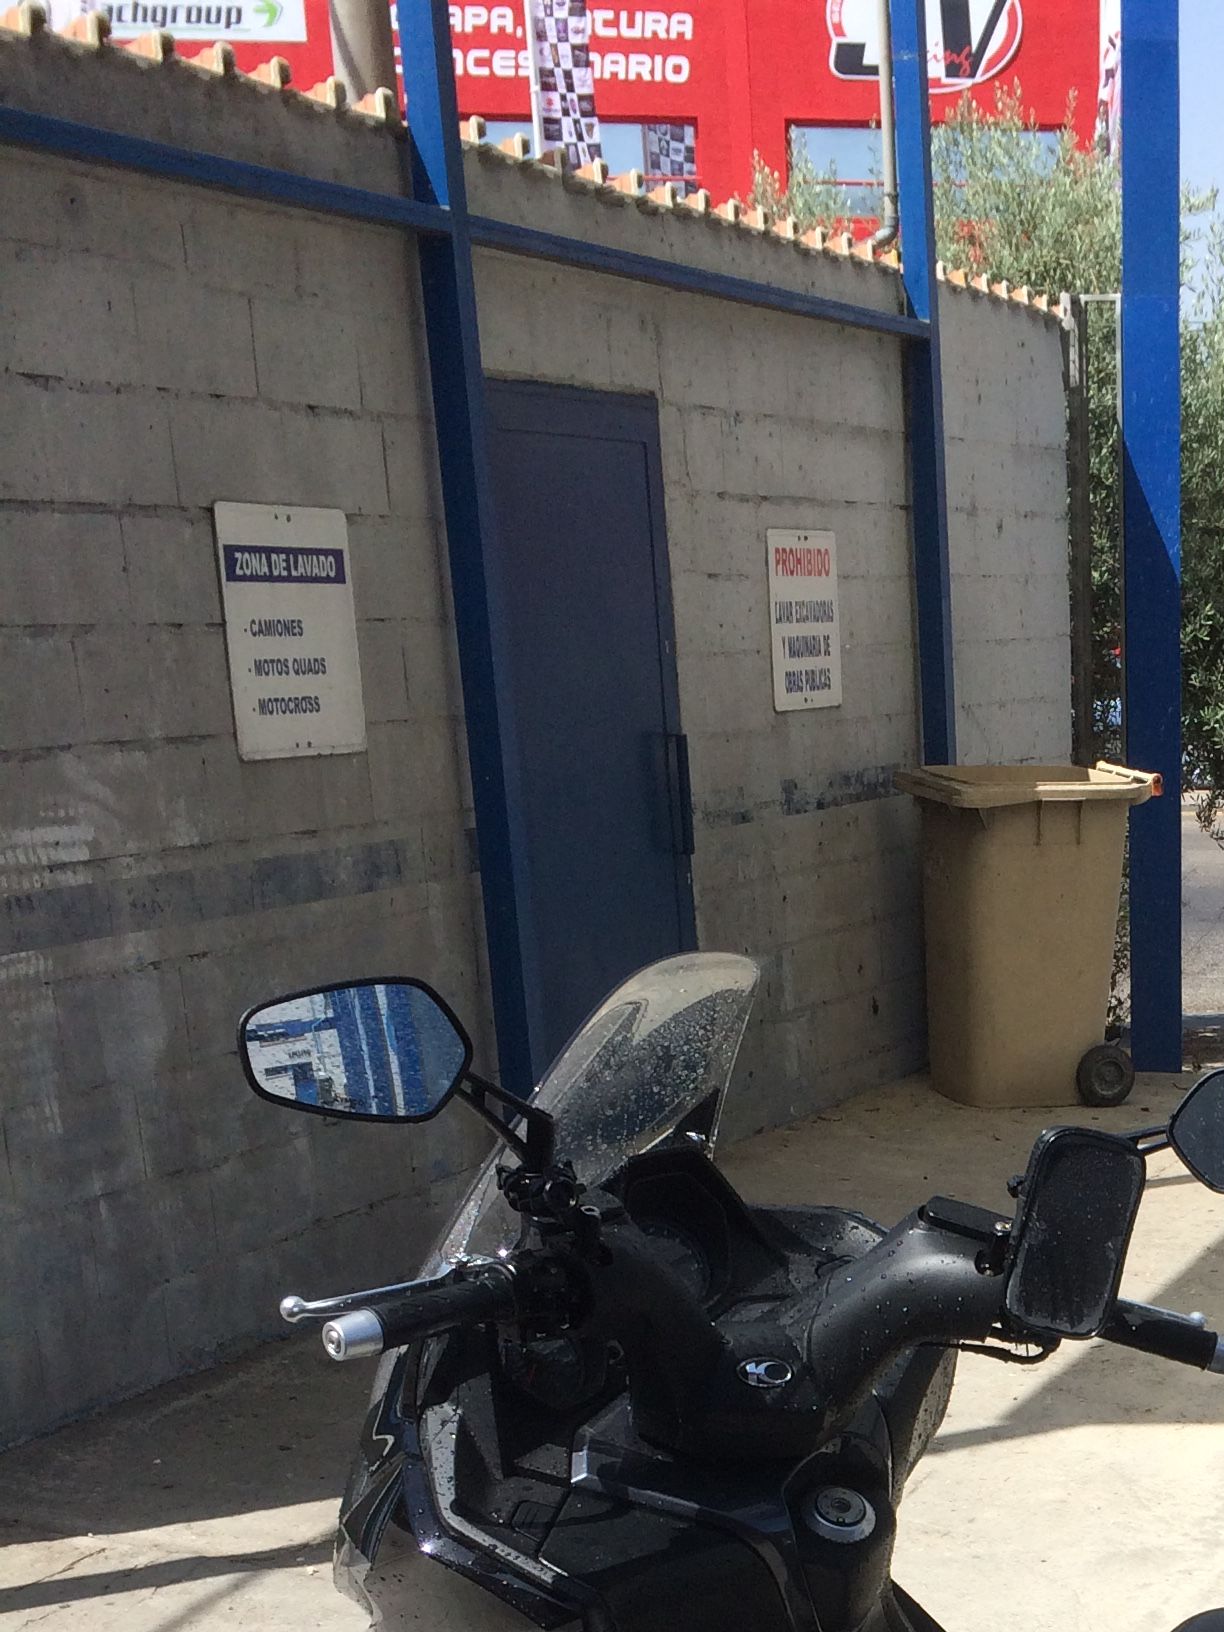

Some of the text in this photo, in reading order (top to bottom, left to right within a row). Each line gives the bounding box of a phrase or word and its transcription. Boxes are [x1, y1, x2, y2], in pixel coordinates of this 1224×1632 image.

[234, 551, 337, 578] ZONA DE LAVADO
[774, 547, 831, 577] PROHIBIDO
[774, 600, 834, 625] LAVAR EXCAVADORAS
[249, 618, 304, 638] CAMIONES
[787, 635, 822, 659] MAQUINARIA
[823, 634, 831, 657] DE
[253, 657, 327, 677] MOTOS QUADS
[784, 670, 804, 694] OBRAS
[258, 695, 321, 716] MOTOCROSS
